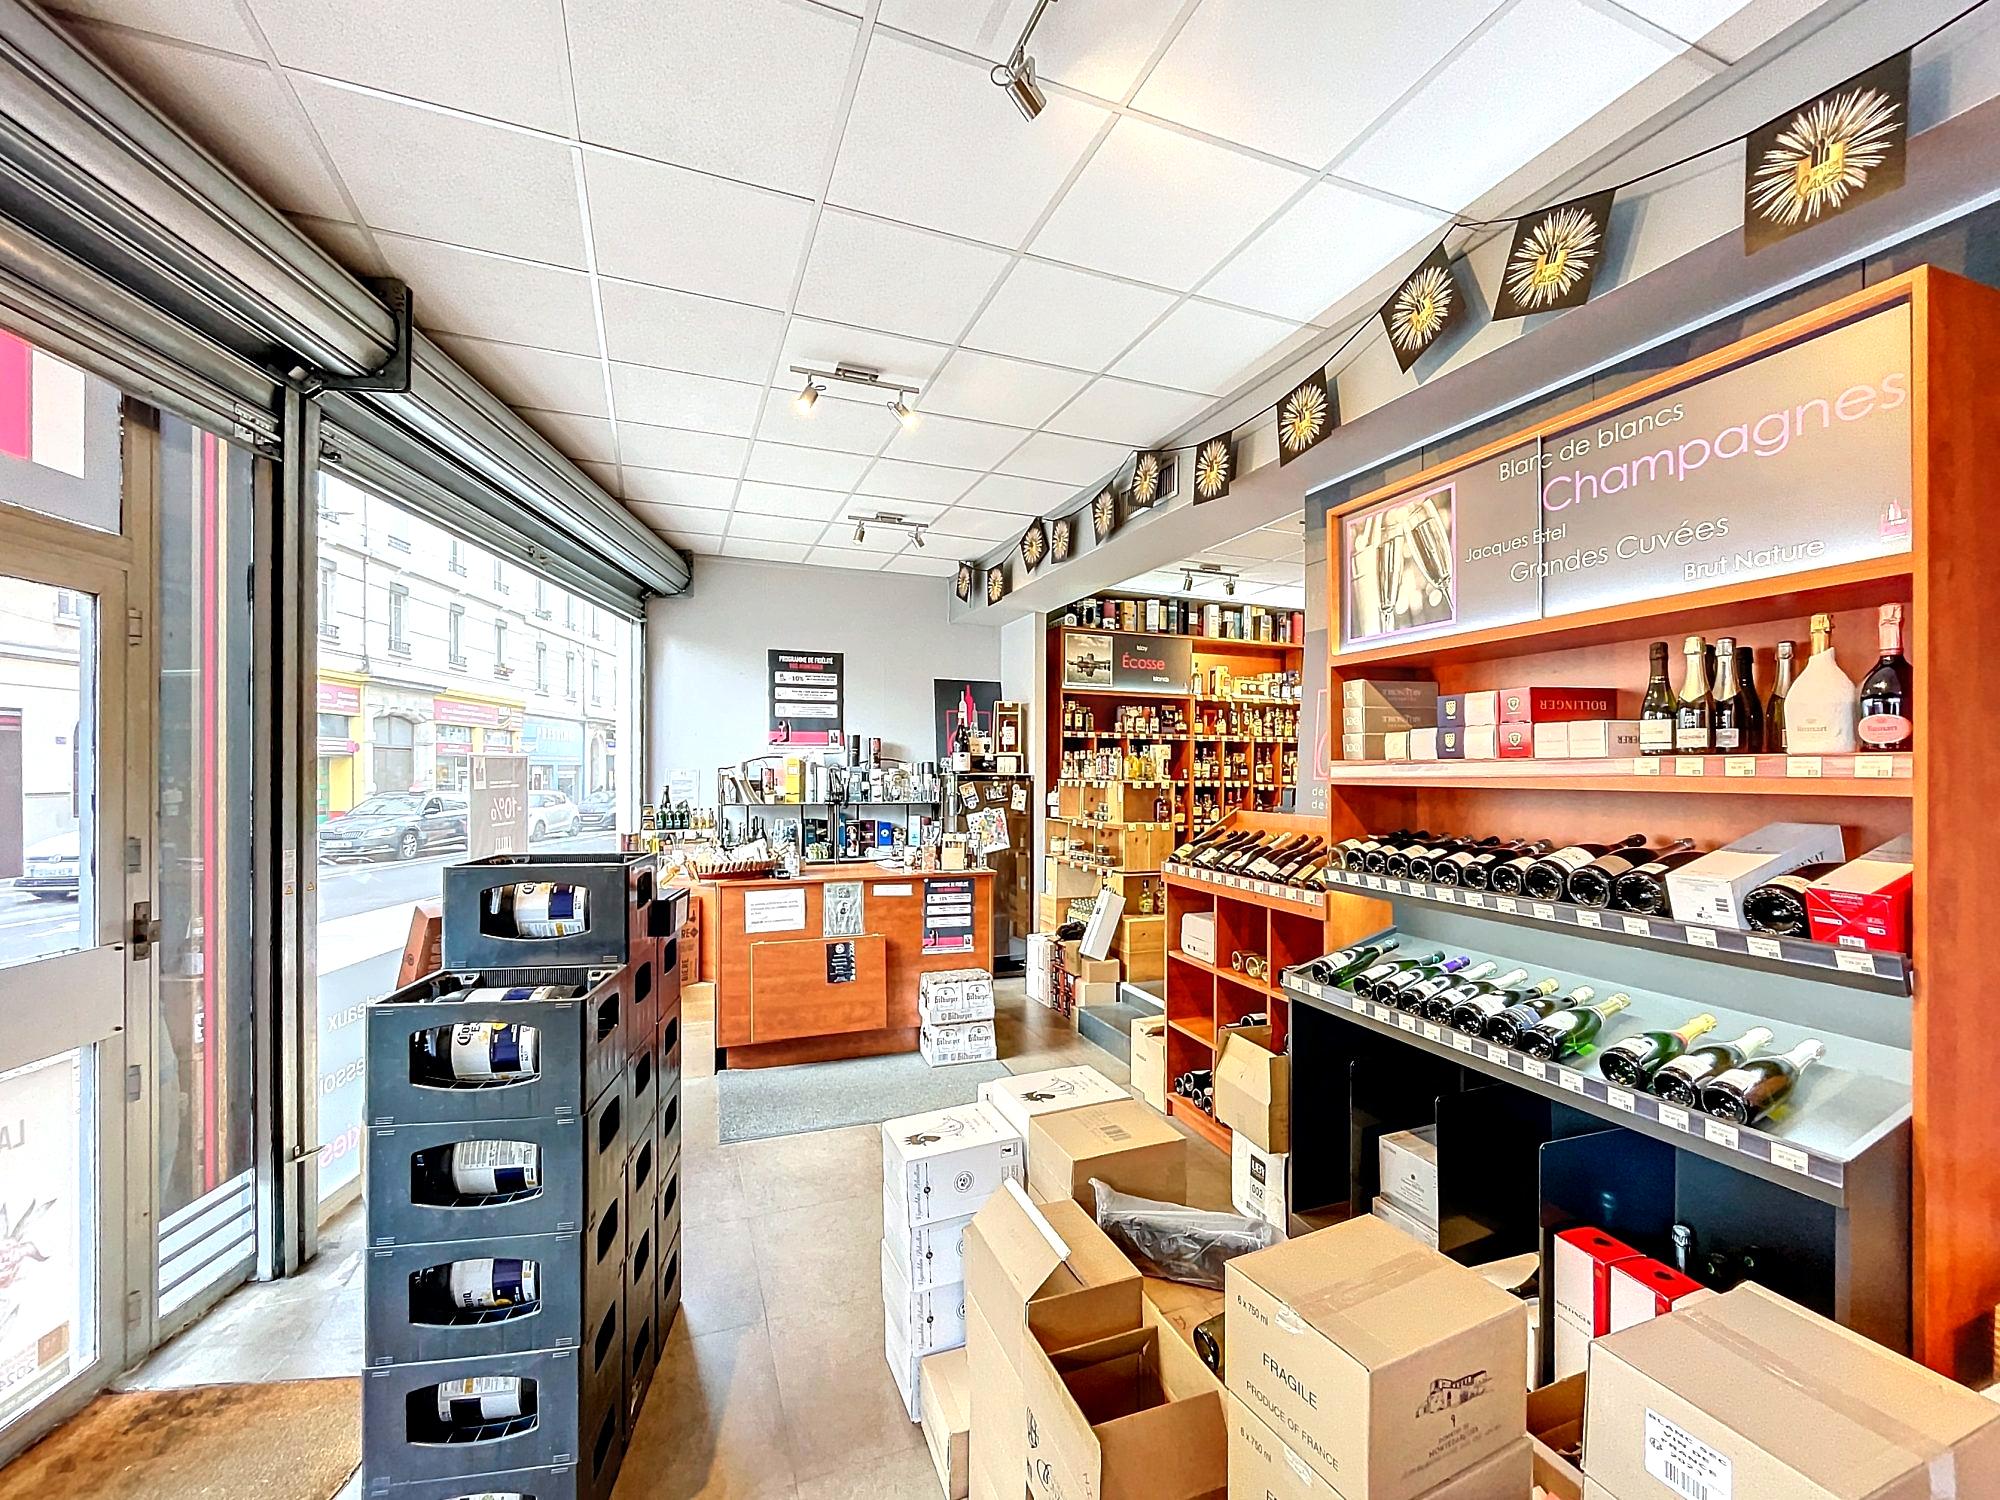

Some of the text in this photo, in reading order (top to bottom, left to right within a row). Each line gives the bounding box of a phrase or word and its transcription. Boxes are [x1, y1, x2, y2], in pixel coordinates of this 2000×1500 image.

[1499, 402, 1685, 483] Blanc de blancs
[1542, 372, 1907, 513] Champagnes
[1465, 523, 1567, 563] Jacques Estel
[1509, 516, 1730, 583] Grandes Cuvées
[1683, 538, 1825, 582] Brut Nature
[1122, 652, 1166, 671] Écosse
[1540, 698, 1607, 711] BOLLINGER
[1237, 1294, 1242, 1305] 6
[1248, 1303, 1260, 1319] 750
[1260, 1314, 1269, 1327] ml
[1263, 1352, 1318, 1410] FRAGILE
[1246, 1380, 1339, 1472] PRODUCE OF FRANCE
[1648, 1413, 1727, 1467] BLANC SEC
[1663, 1431, 1709, 1463] VIN DE
[1251, 1436, 1263, 1455] 750
[1263, 1450, 1272, 1463] ml
[1661, 1437, 1717, 1477] FRANCE
